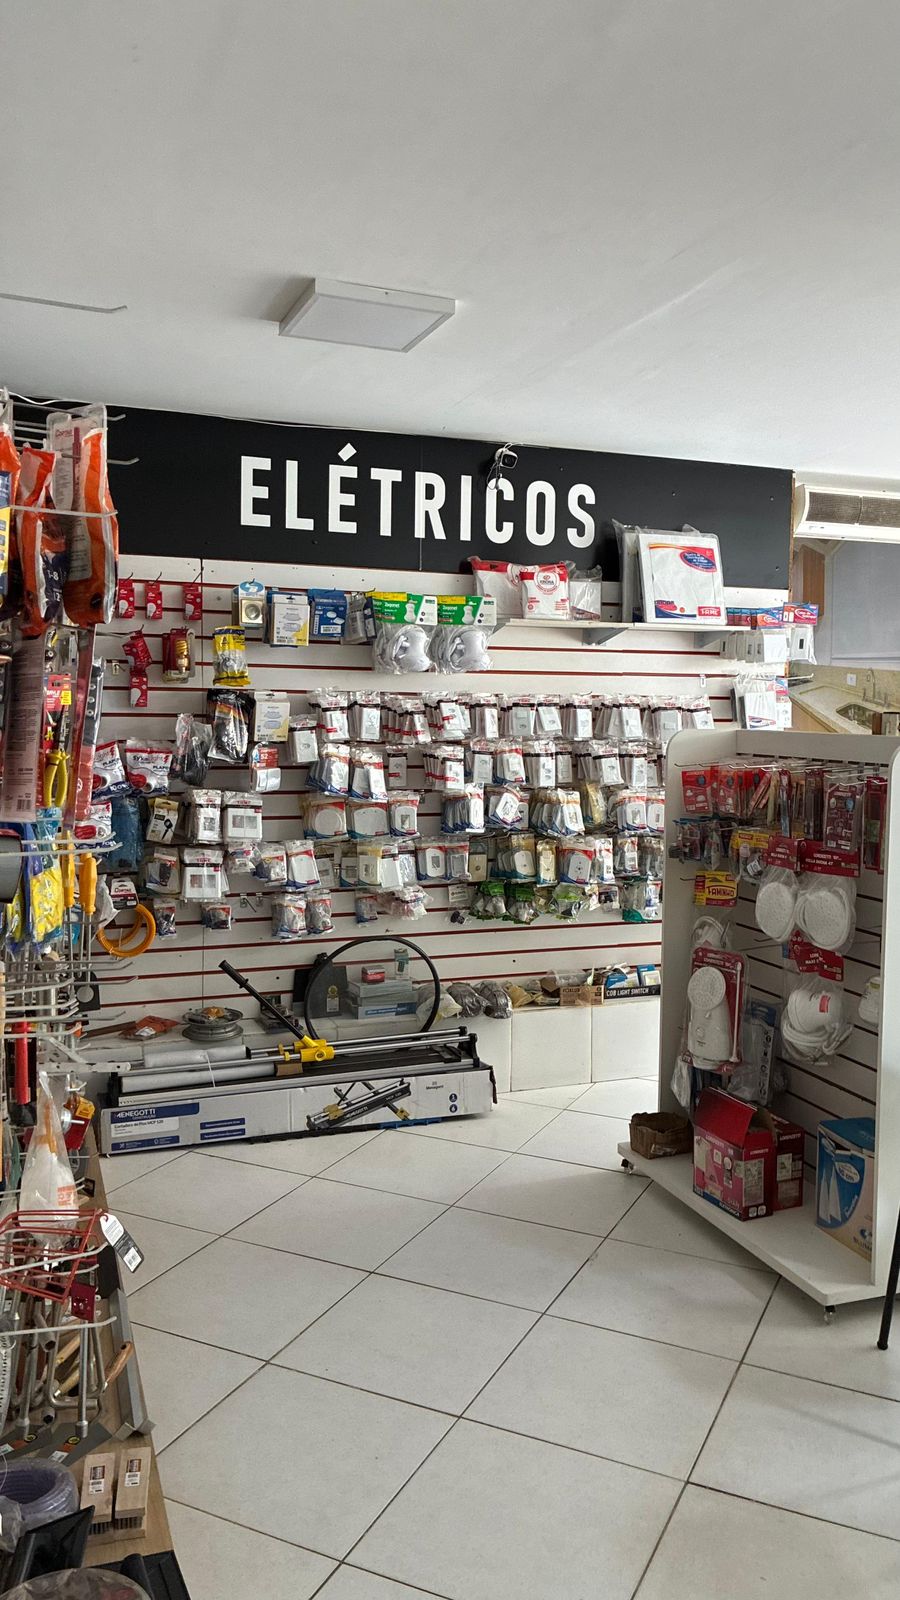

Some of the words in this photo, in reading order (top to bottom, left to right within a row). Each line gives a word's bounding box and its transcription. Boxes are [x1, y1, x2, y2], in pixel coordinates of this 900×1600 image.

[240, 443, 597, 548] ELÉTRICOS
[606, 989, 617, 997] COB
[617, 988, 630, 996] LIGHT
[631, 987, 650, 995] SWITCH
